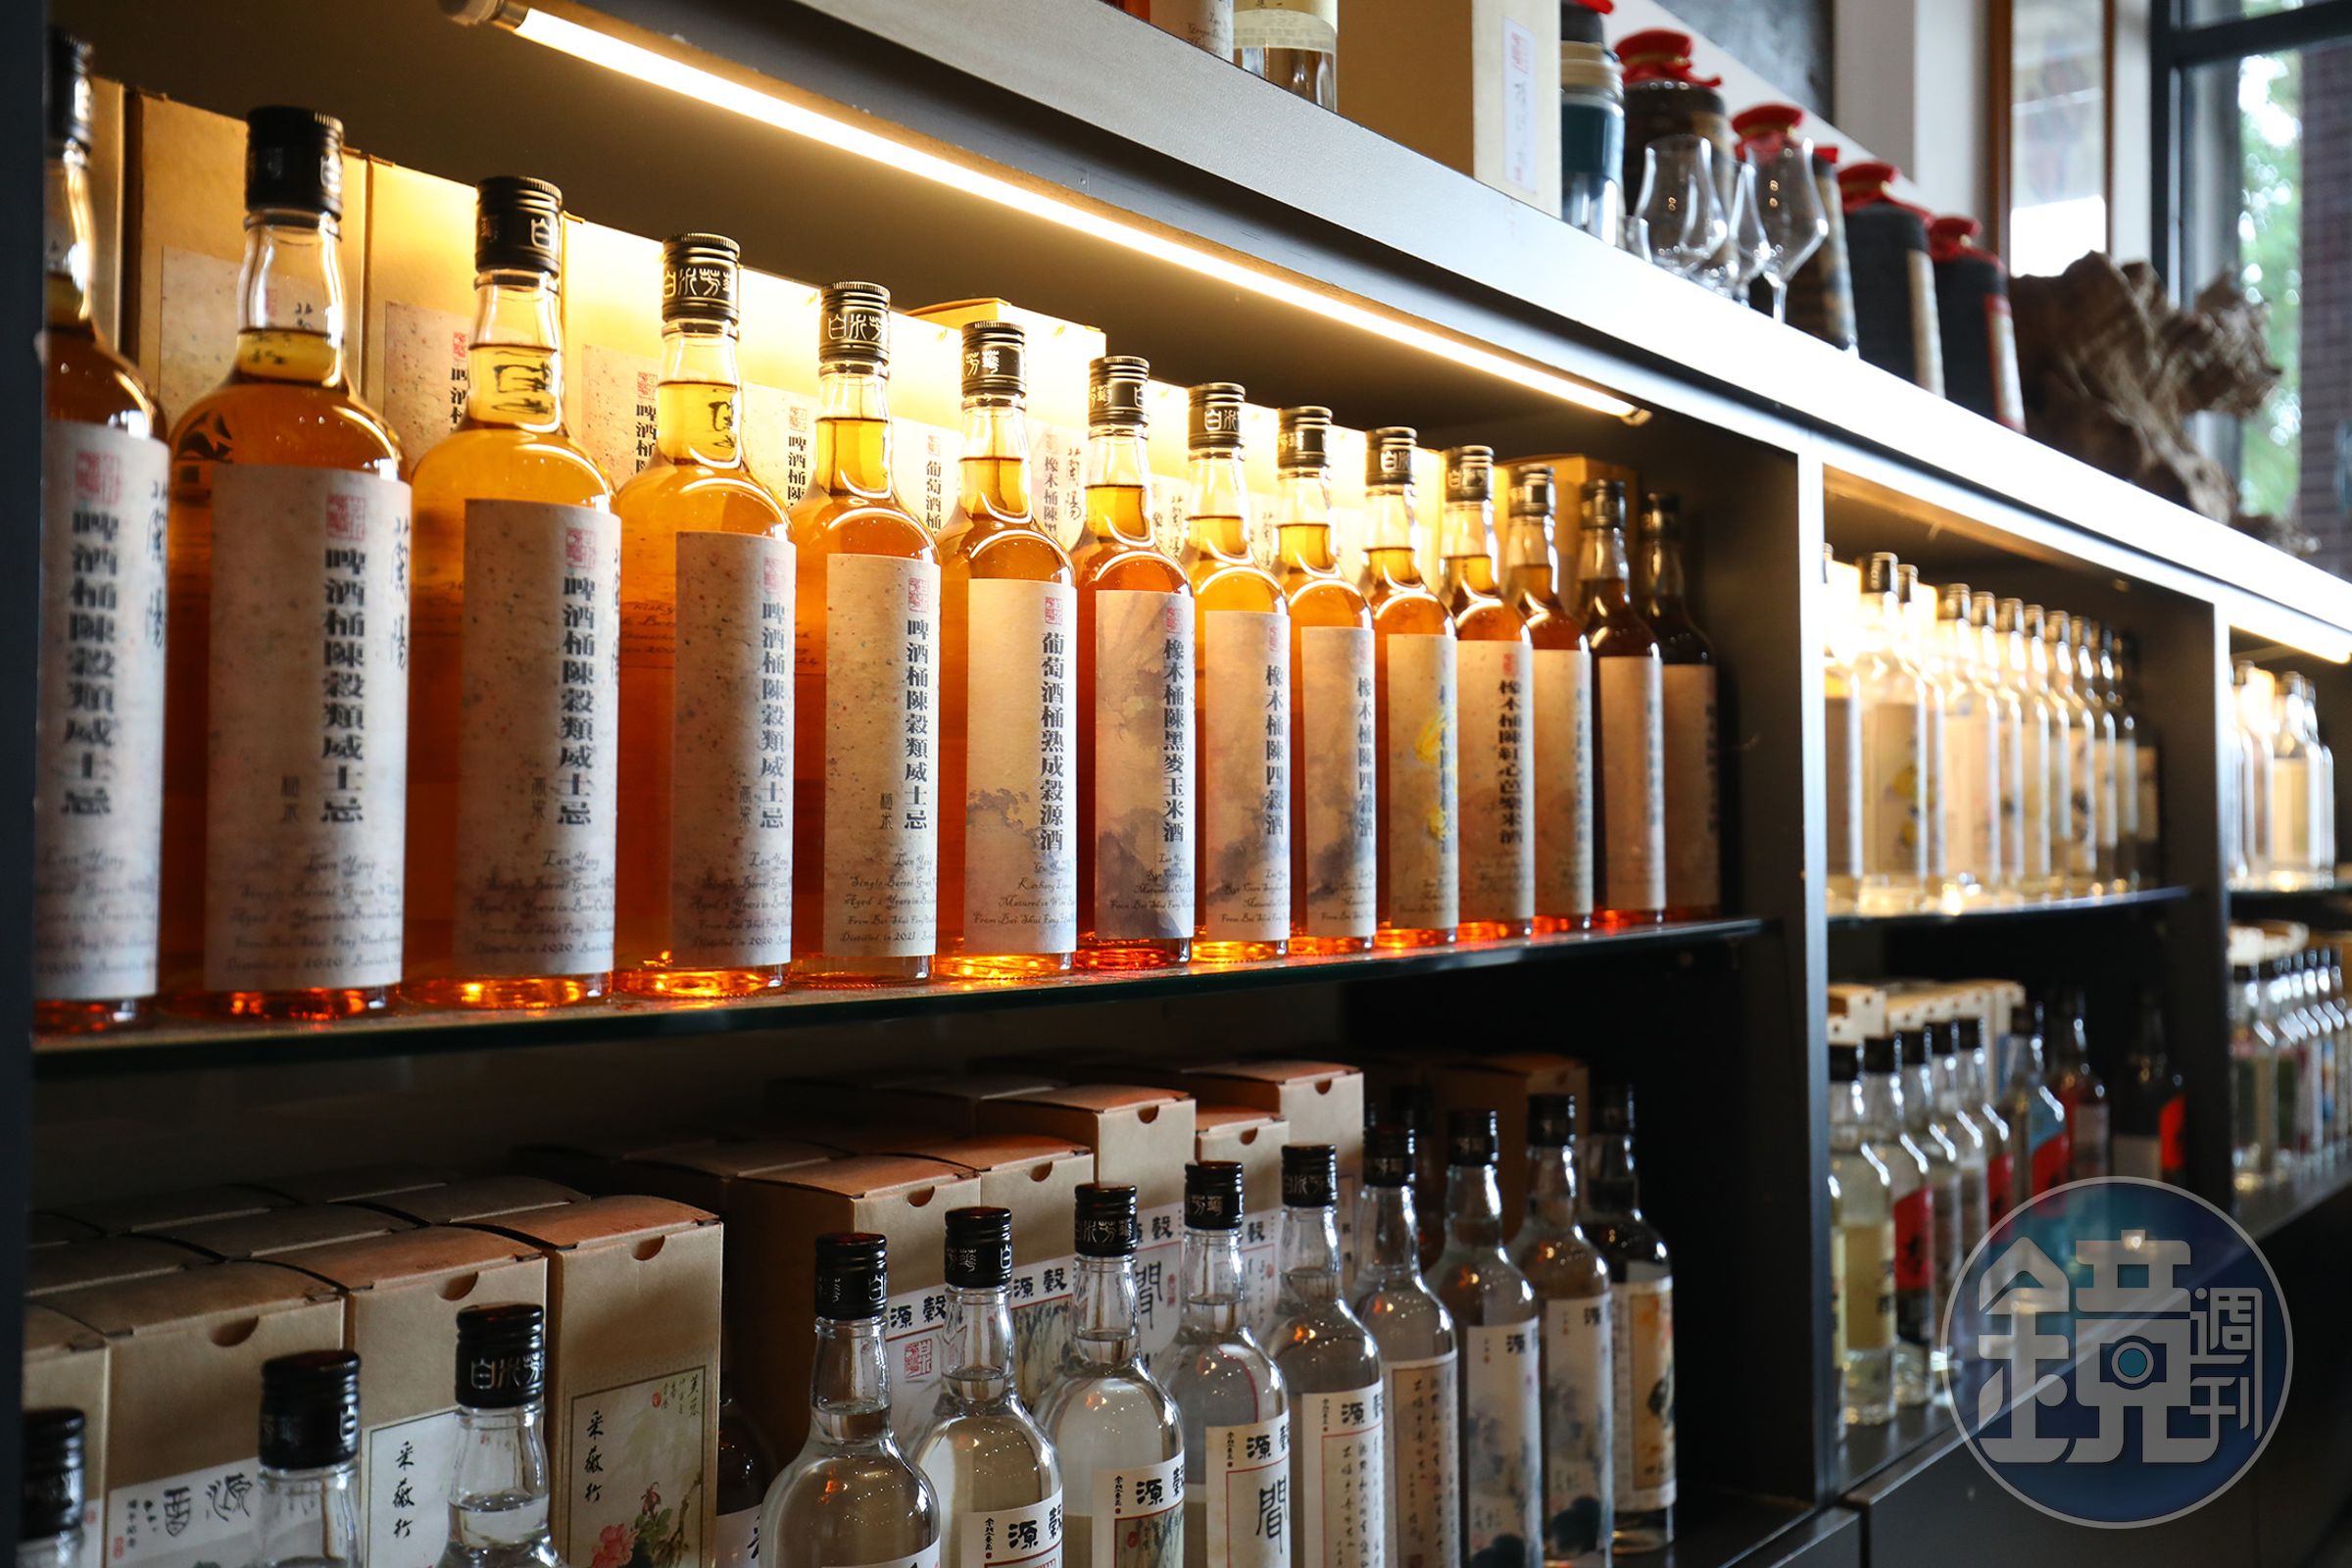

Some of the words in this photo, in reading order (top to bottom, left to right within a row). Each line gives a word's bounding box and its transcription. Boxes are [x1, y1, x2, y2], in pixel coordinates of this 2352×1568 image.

[557, 576, 596, 825] 啤酒桶陳穀類威士忌
[760, 602, 785, 829] 啤酒桶陳穀類威士忌
[904, 619, 929, 830] 啤酒桶陳穀類威士忌
[1040, 632, 1064, 851] 葡萄酒桶熟成穀源酒
[1163, 639, 1185, 843] 橡木桶陳黑麥玉米酒
[1265, 664, 1284, 836] 橡木桶陳四穀酒
